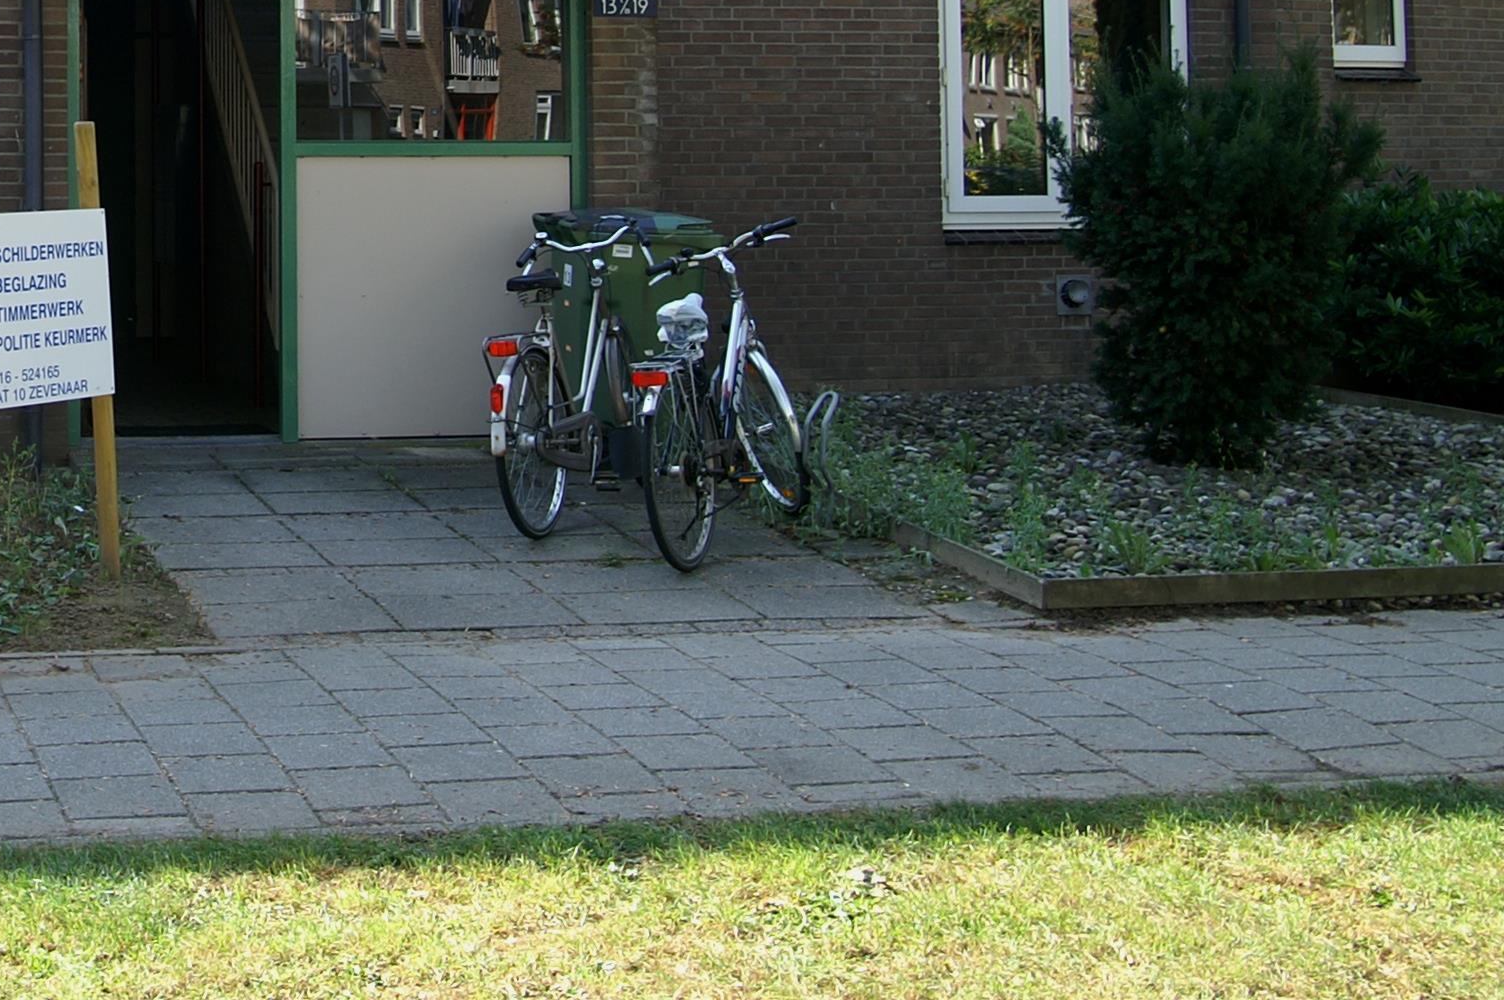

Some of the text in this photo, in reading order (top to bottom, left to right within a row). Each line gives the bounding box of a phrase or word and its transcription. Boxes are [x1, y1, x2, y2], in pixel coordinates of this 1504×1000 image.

[45, 326, 108, 347] KEURMERK
[21, 365, 60, 382] 524165
[14, 387, 26, 401] 10
[29, 380, 88, 400] ZEVENAAR
